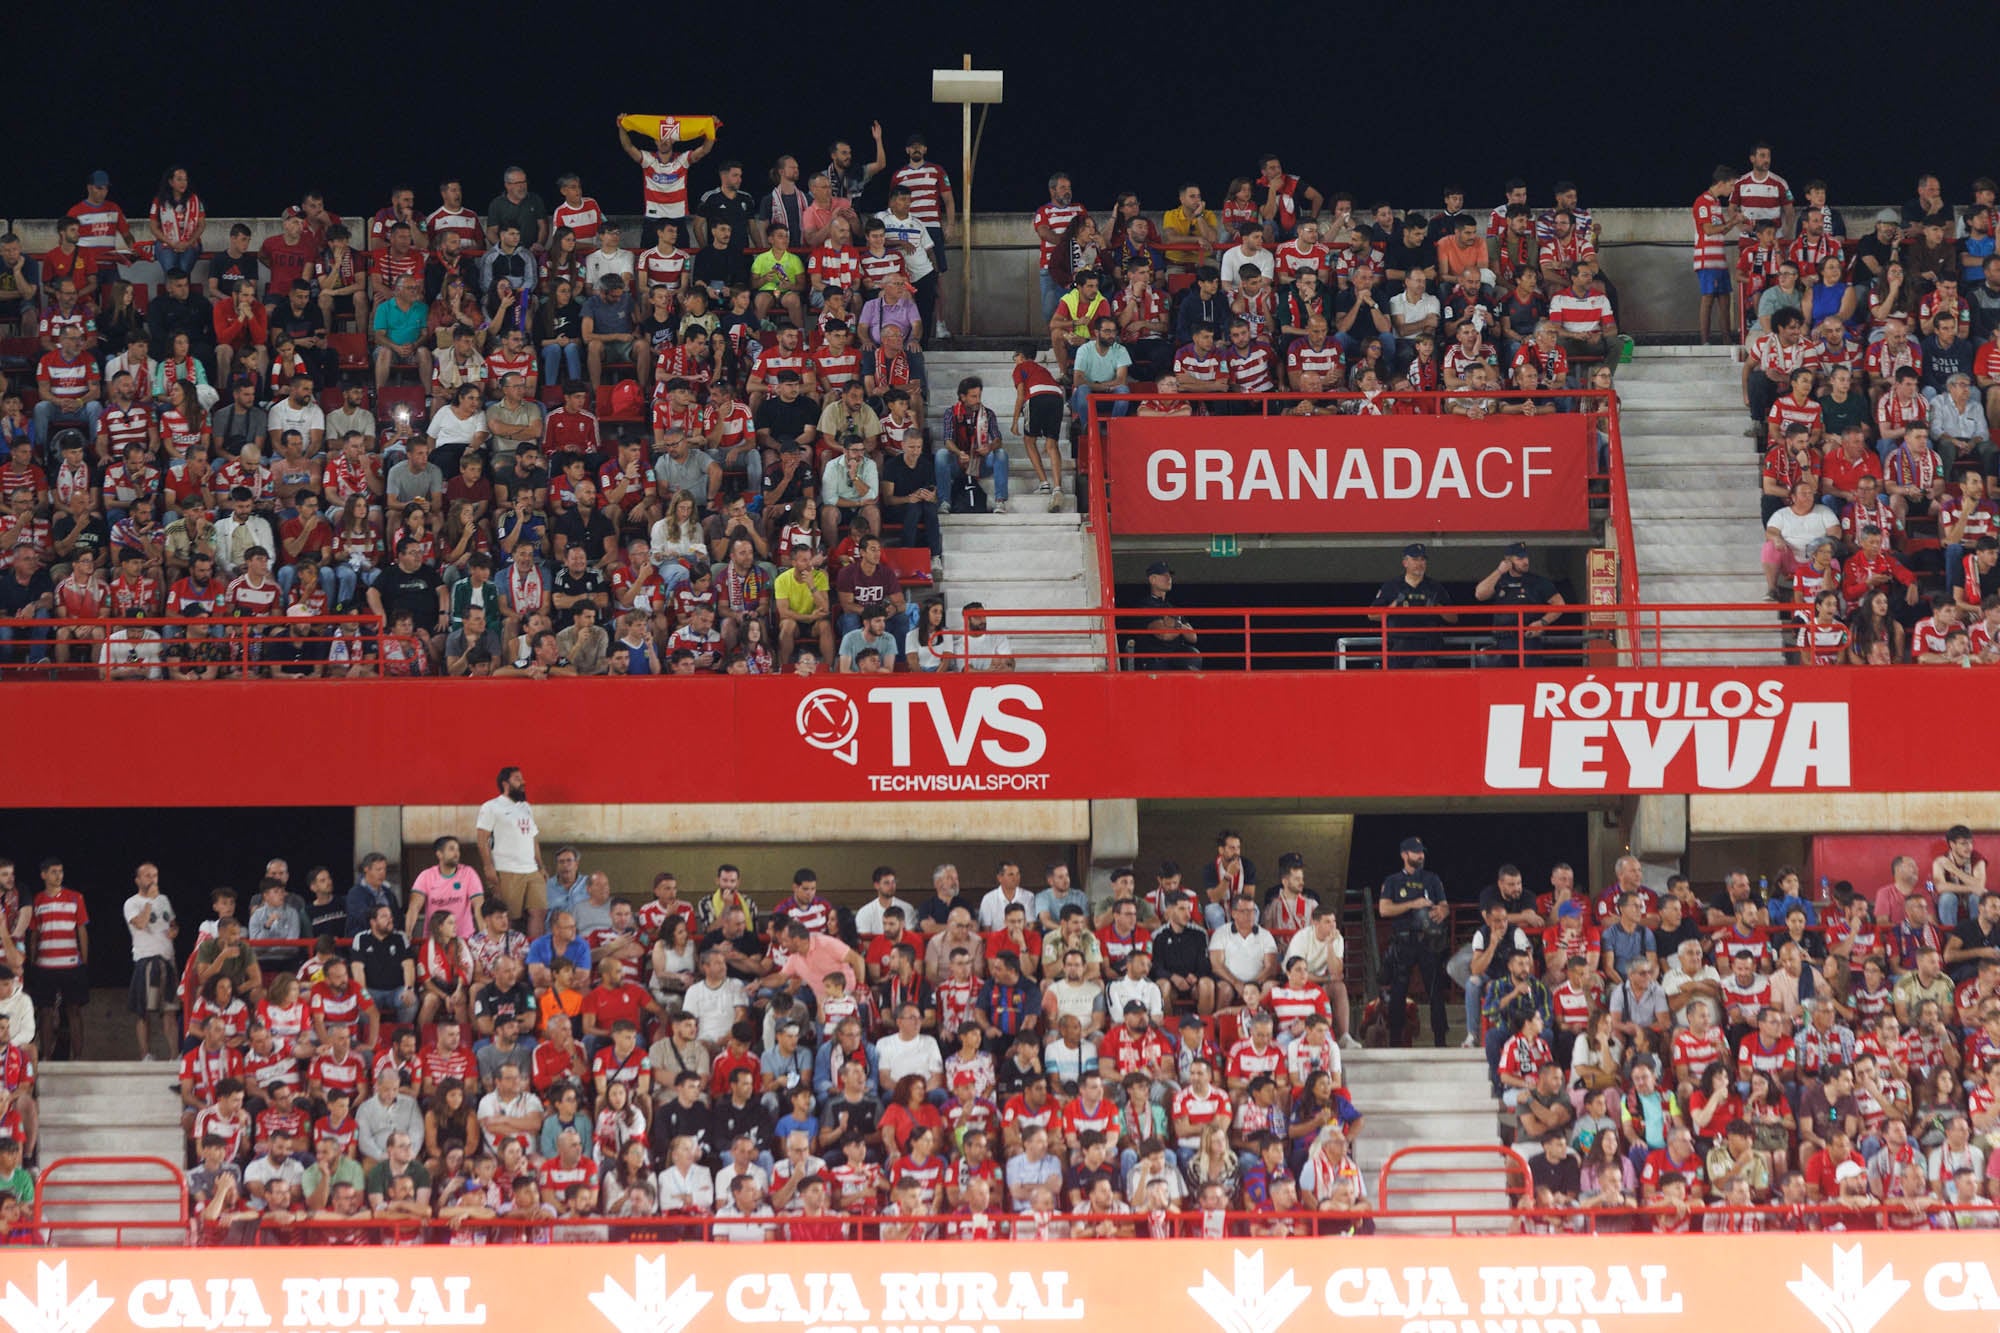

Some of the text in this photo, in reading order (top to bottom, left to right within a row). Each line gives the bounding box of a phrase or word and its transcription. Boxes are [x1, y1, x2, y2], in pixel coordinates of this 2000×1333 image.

[1533, 674, 1785, 719] RÓTULOS
[867, 683, 1047, 768] TVS
[1484, 701, 1851, 790] LEYVA
[127, 1276, 488, 1331] CAJA RURAL
[725, 1270, 1086, 1327] CAJA RURAL
[1324, 1264, 1684, 1321] CAJA RURAL
